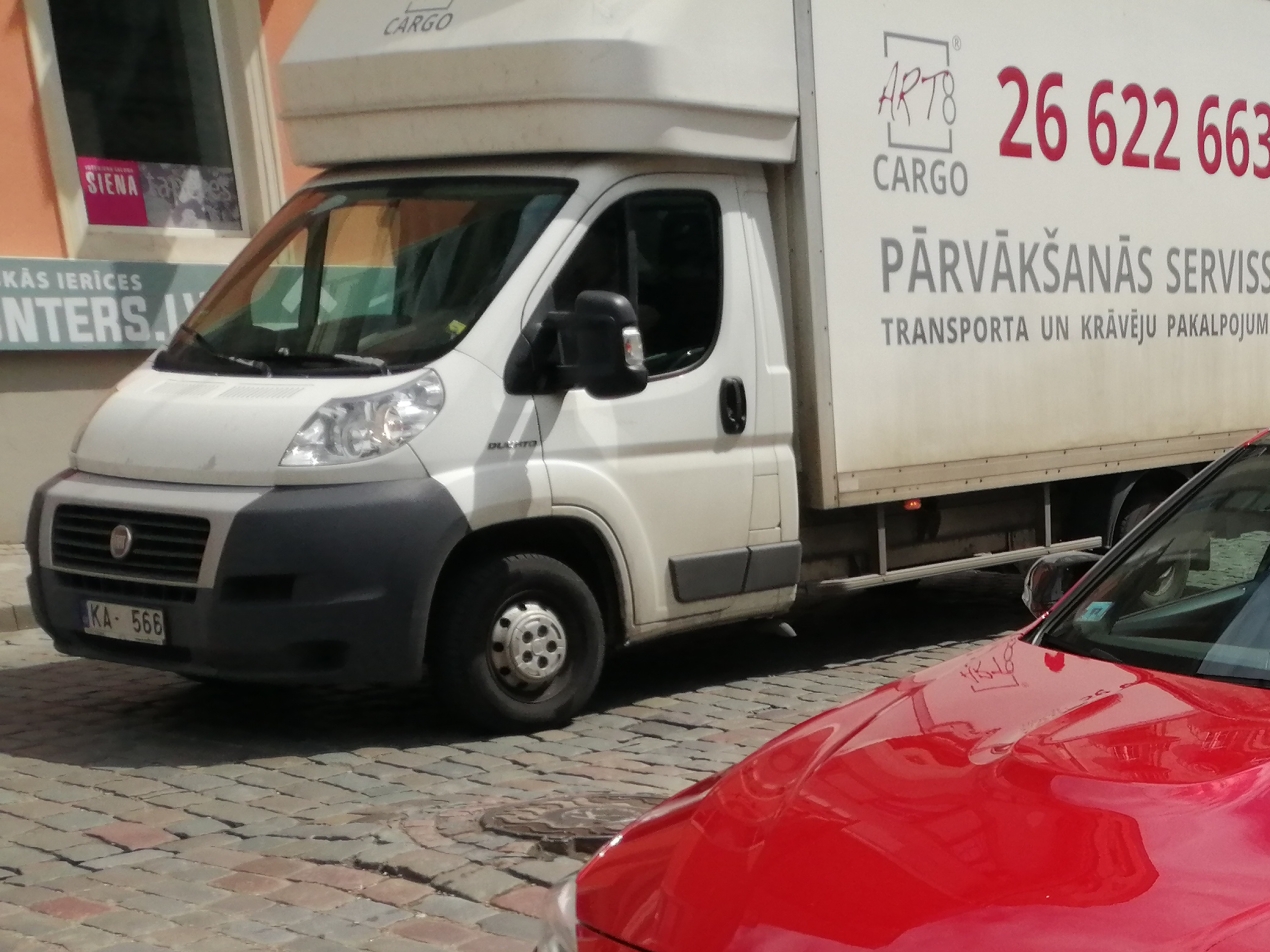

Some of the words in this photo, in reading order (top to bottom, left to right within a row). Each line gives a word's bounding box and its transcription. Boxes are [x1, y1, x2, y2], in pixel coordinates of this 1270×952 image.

[383, 13, 454, 36] CARGO
[996, 65, 1068, 162] 26
[1087, 79, 1180, 171] 622
[85, 171, 138, 196] SIENA
[873, 153, 968, 197] CARGO
[0, 267, 50, 289] KĀS
[57, 269, 143, 291] IERĪCES
[880, 226, 1153, 294] PĀRVĀKŠANĀS
[881, 315, 1029, 346] TRANSPORTA
[1041, 315, 1069, 341] UN
[1080, 308, 1157, 346] KRĀVĒJU
